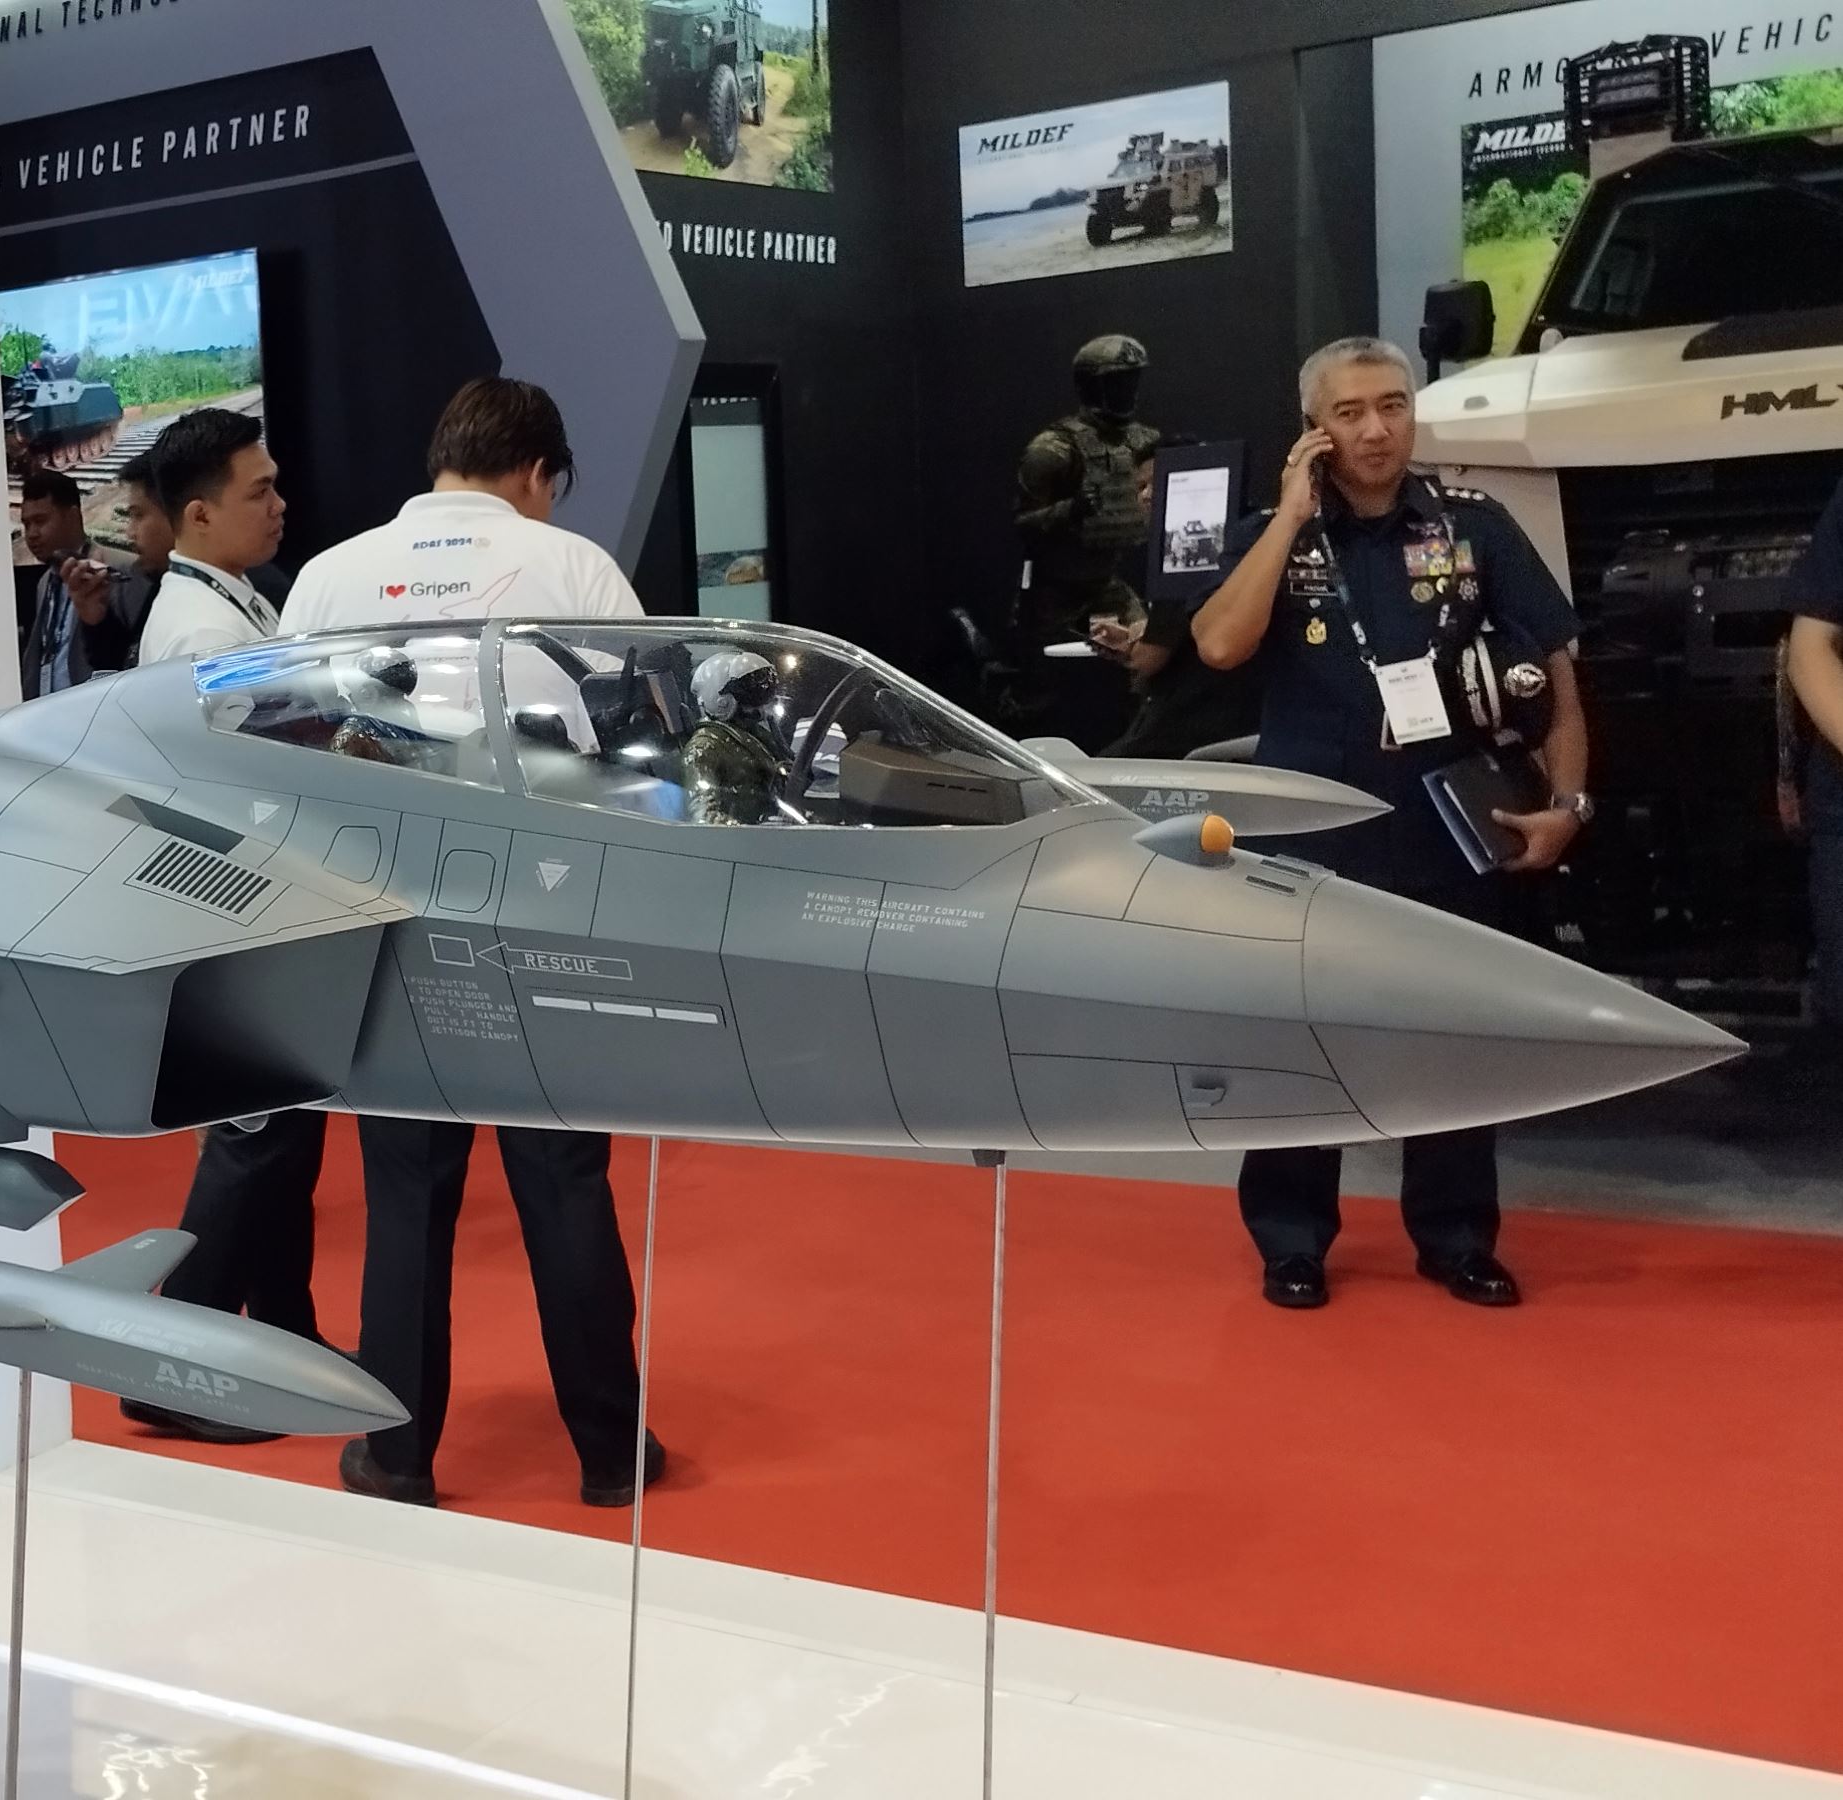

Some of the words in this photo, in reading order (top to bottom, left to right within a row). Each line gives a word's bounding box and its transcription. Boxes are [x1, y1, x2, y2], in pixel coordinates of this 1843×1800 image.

[1711, 13, 1833, 58] VEHIC
[19, 136, 144, 189] VEHICLE
[162, 104, 309, 163] PARTNER
[976, 122, 1075, 155] MILDEF
[682, 223, 757, 259] VEHICLE
[763, 231, 837, 264] PARTNER
[379, 585, 384, 600] I
[410, 581, 471, 599] Gripen
[1140, 789, 1210, 807] AAP
[803, 902, 810, 910] A
[814, 903, 853, 915] CANOPY
[857, 908, 905, 921] REMOVER
[908, 914, 969, 928] CONTAINING
[806, 891, 851, 904] WARNING
[855, 897, 878, 908] THIS
[881, 900, 931, 913] AIRCRAFT
[934, 906, 986, 920] CONTAINS
[801, 912, 815, 921] AN
[818, 914, 873, 928] EXPLOSIVE
[876, 921, 916, 933] CHARGE
[524, 953, 599, 974] RESCUE
[435, 988, 461, 998] OPEN
[419, 996, 445, 1006] PUSH
[498, 1004, 517, 1013] AND
[423, 1006, 450, 1016] PULL
[476, 1011, 515, 1023] HANDLE
[480, 1031, 519, 1041] CANOPY
[154, 1360, 240, 1398] AAP
